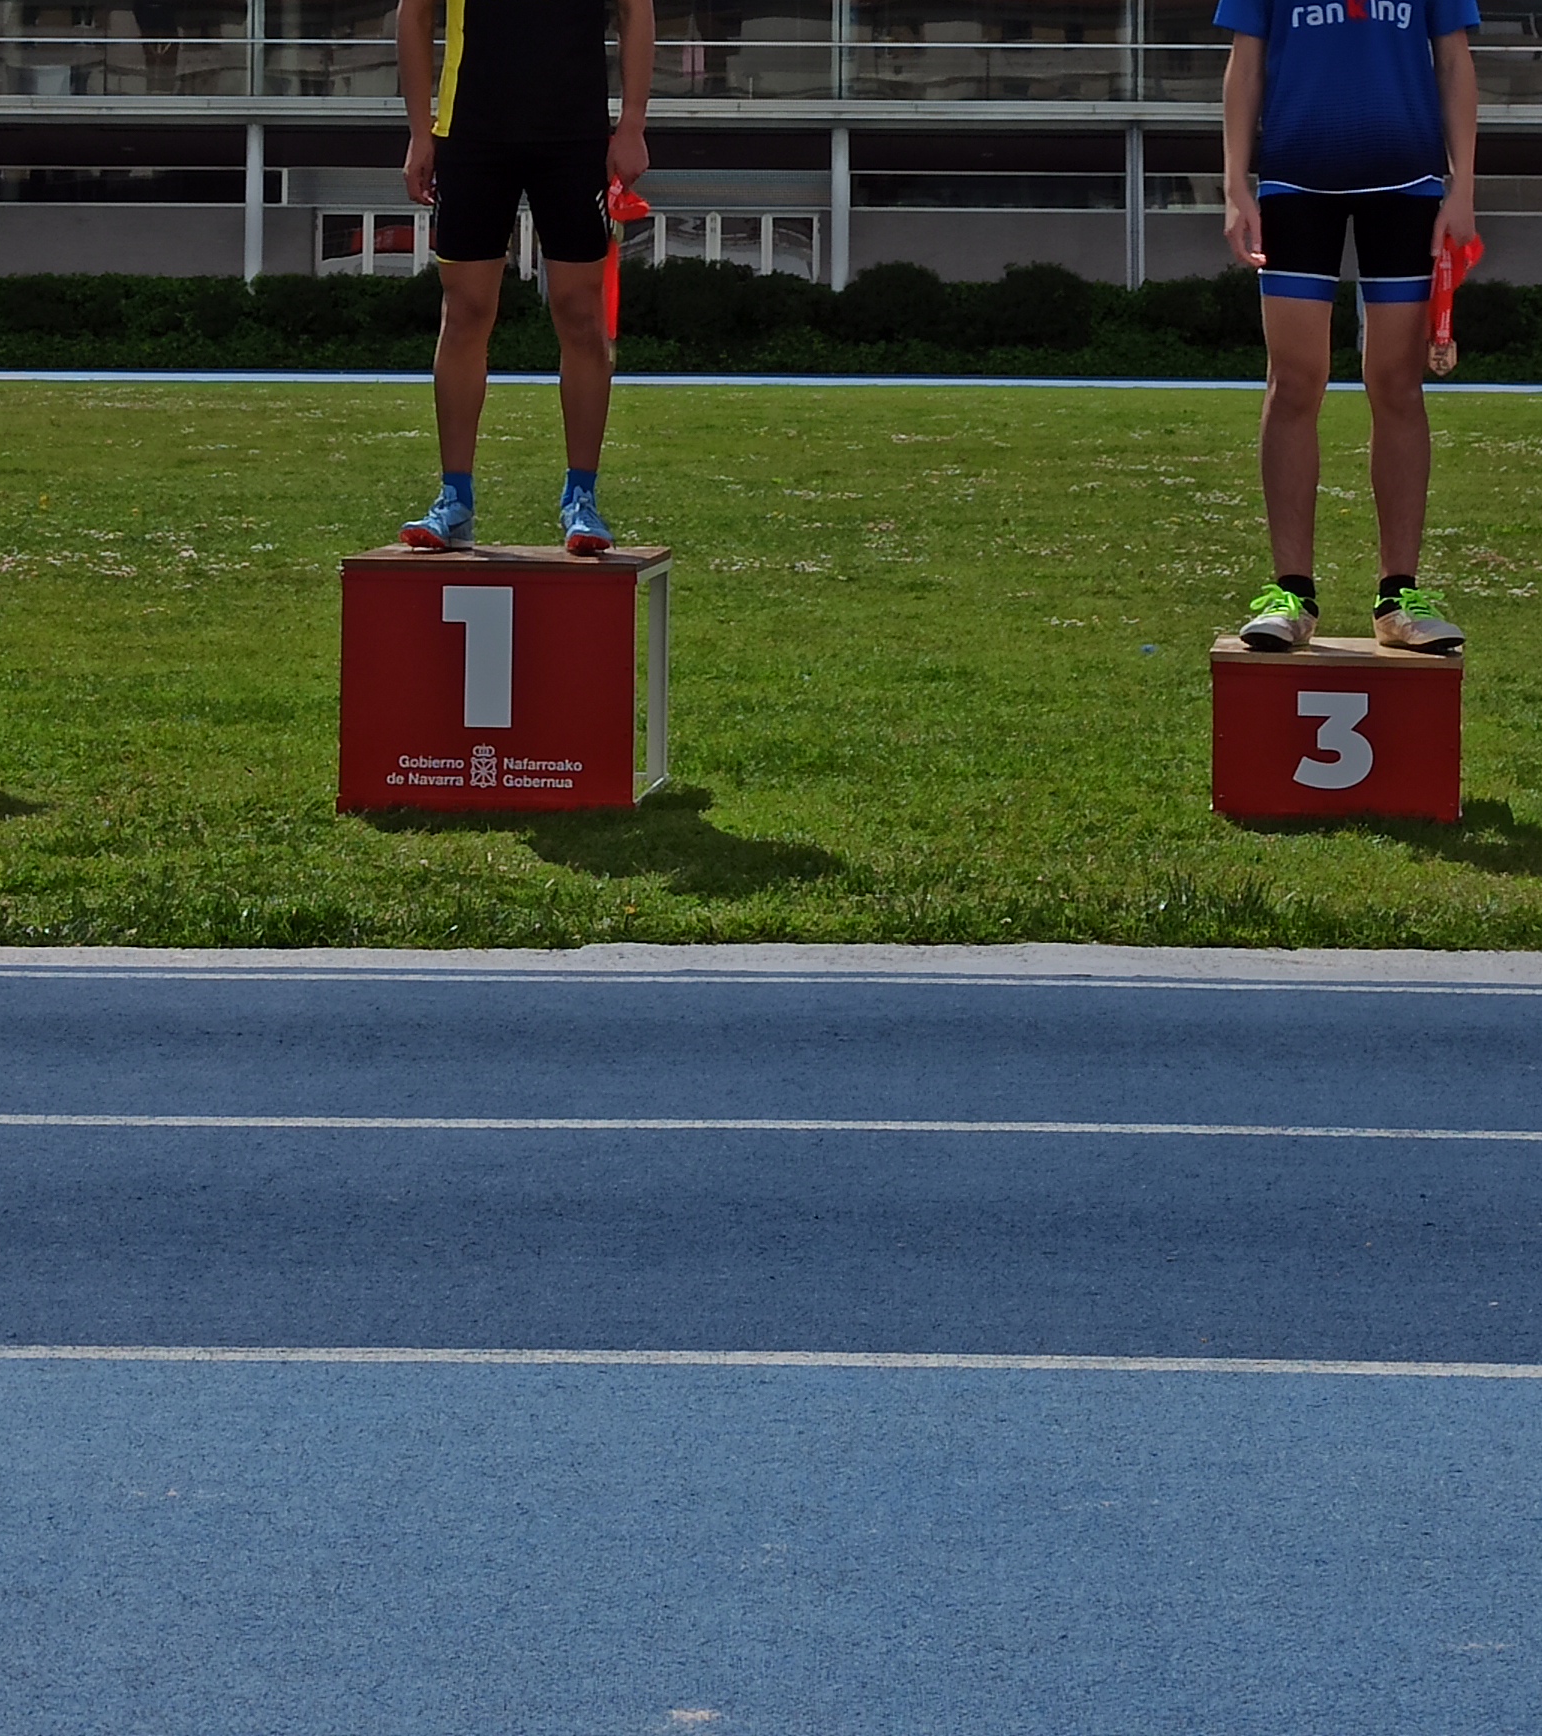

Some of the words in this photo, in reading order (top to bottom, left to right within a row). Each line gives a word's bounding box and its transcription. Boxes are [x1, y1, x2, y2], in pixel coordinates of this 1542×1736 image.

[442, 585, 513, 728] 1
[1292, 691, 1374, 790] 3
[398, 755, 465, 770] Gobierno
[503, 757, 583, 772] Nafarroako
[386, 772, 404, 786] de
[408, 773, 464, 787] Navarra
[503, 774, 574, 789] Gobernua
